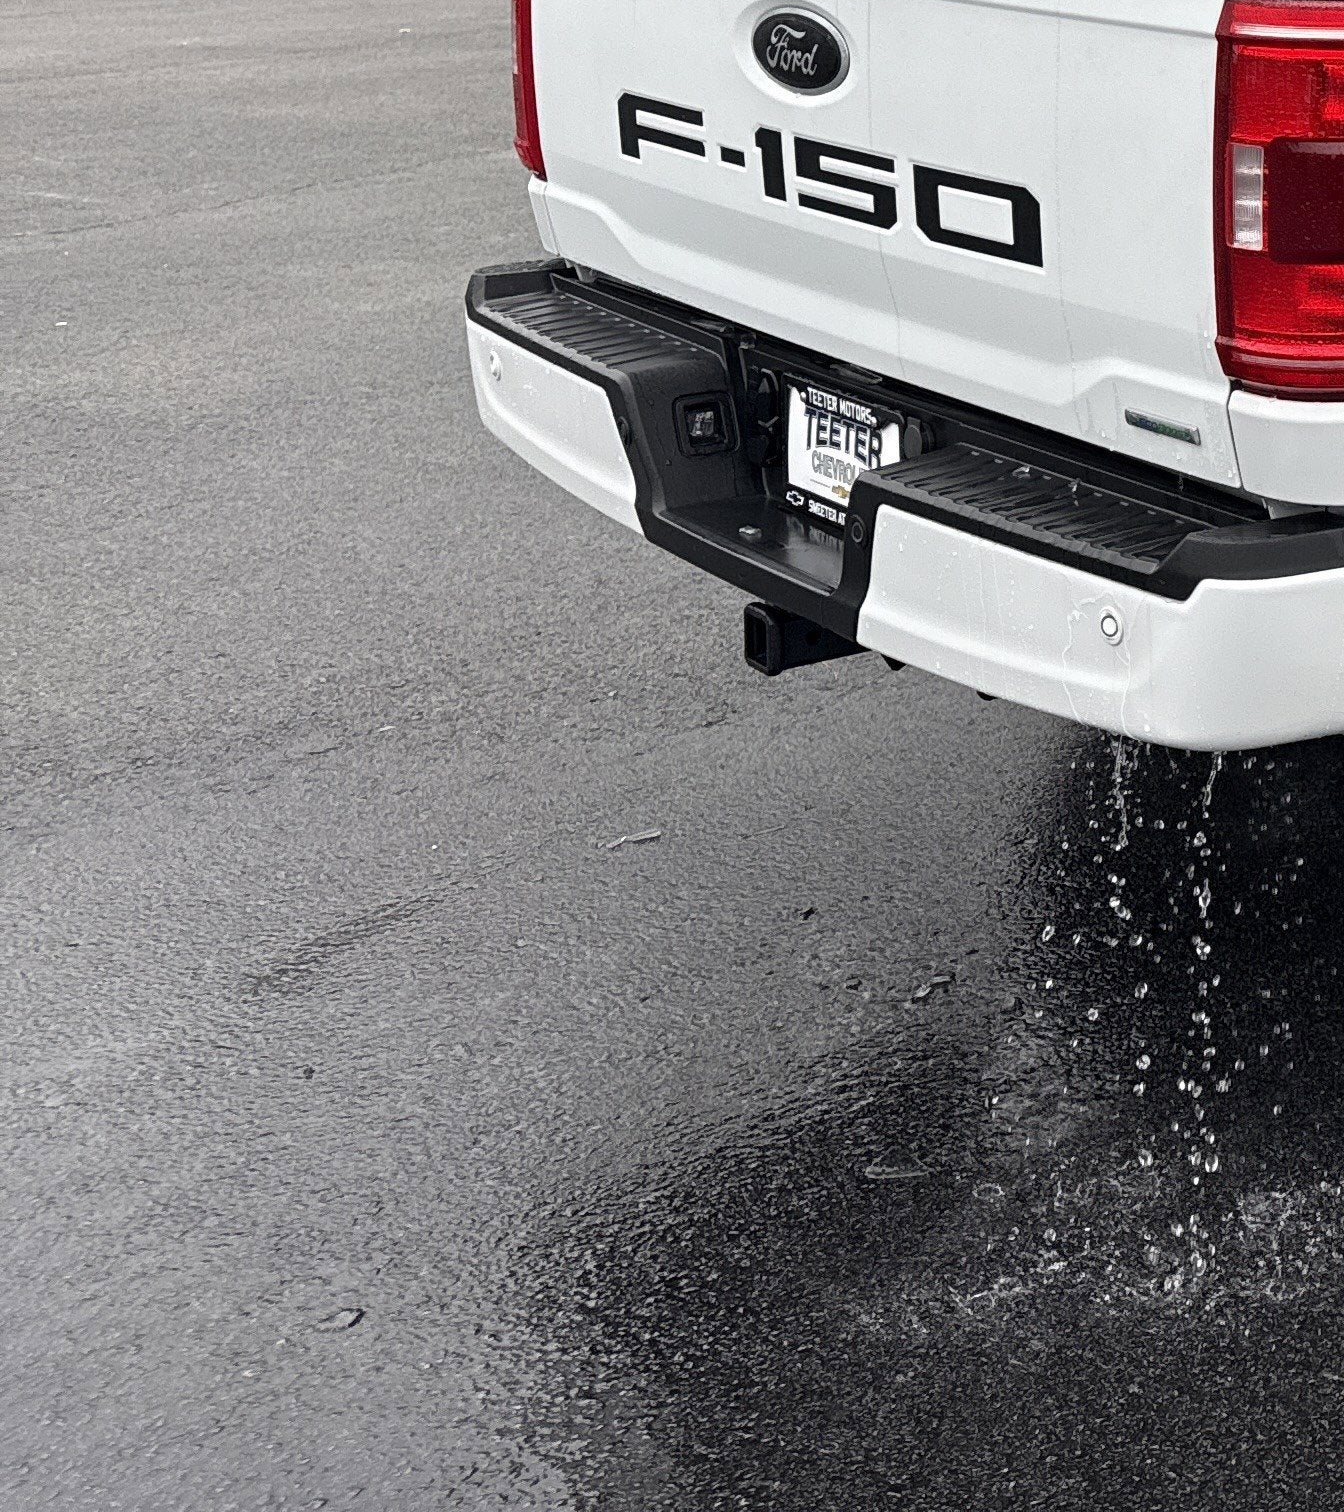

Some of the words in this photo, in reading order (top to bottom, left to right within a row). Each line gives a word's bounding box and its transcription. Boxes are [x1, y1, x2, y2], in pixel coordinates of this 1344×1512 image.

[766, 24, 819, 76] Ford
[617, 91, 1045, 269] F-150
[807, 387, 838, 412] TEETER
[839, 398, 873, 426] MOTORS
[804, 406, 882, 470] TEETER
[811, 450, 865, 486] CHEVRO
